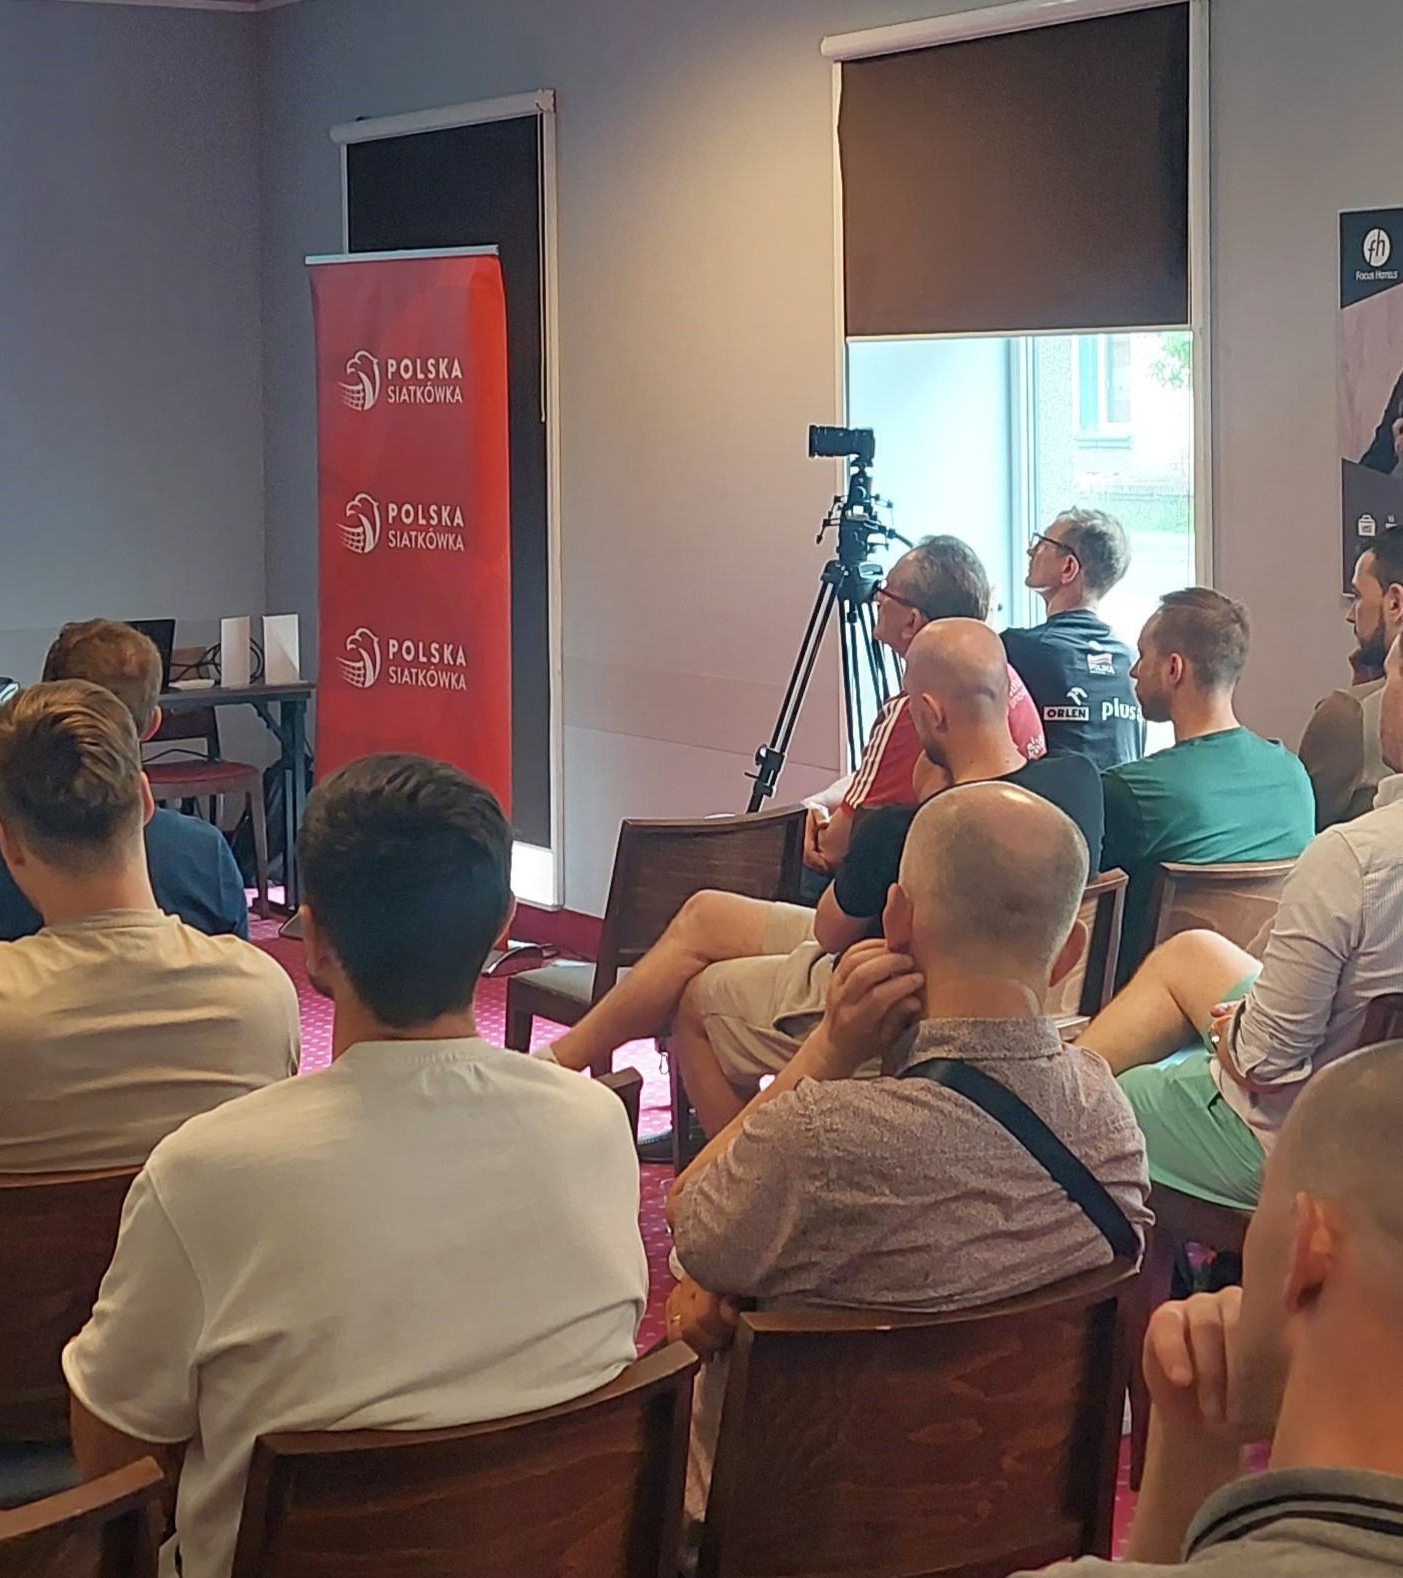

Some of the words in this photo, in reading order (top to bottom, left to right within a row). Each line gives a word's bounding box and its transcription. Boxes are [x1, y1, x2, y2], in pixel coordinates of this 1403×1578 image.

[387, 358, 463, 379] POLSKA
[387, 381, 463, 403] SIATKÓWKA
[388, 503, 464, 527] POLSKA
[388, 528, 465, 552] SIATKÓWKA
[389, 639, 467, 667] POLSKA
[389, 665, 467, 691] SIATKÓWKA
[1046, 709, 1086, 718] ORLEN
